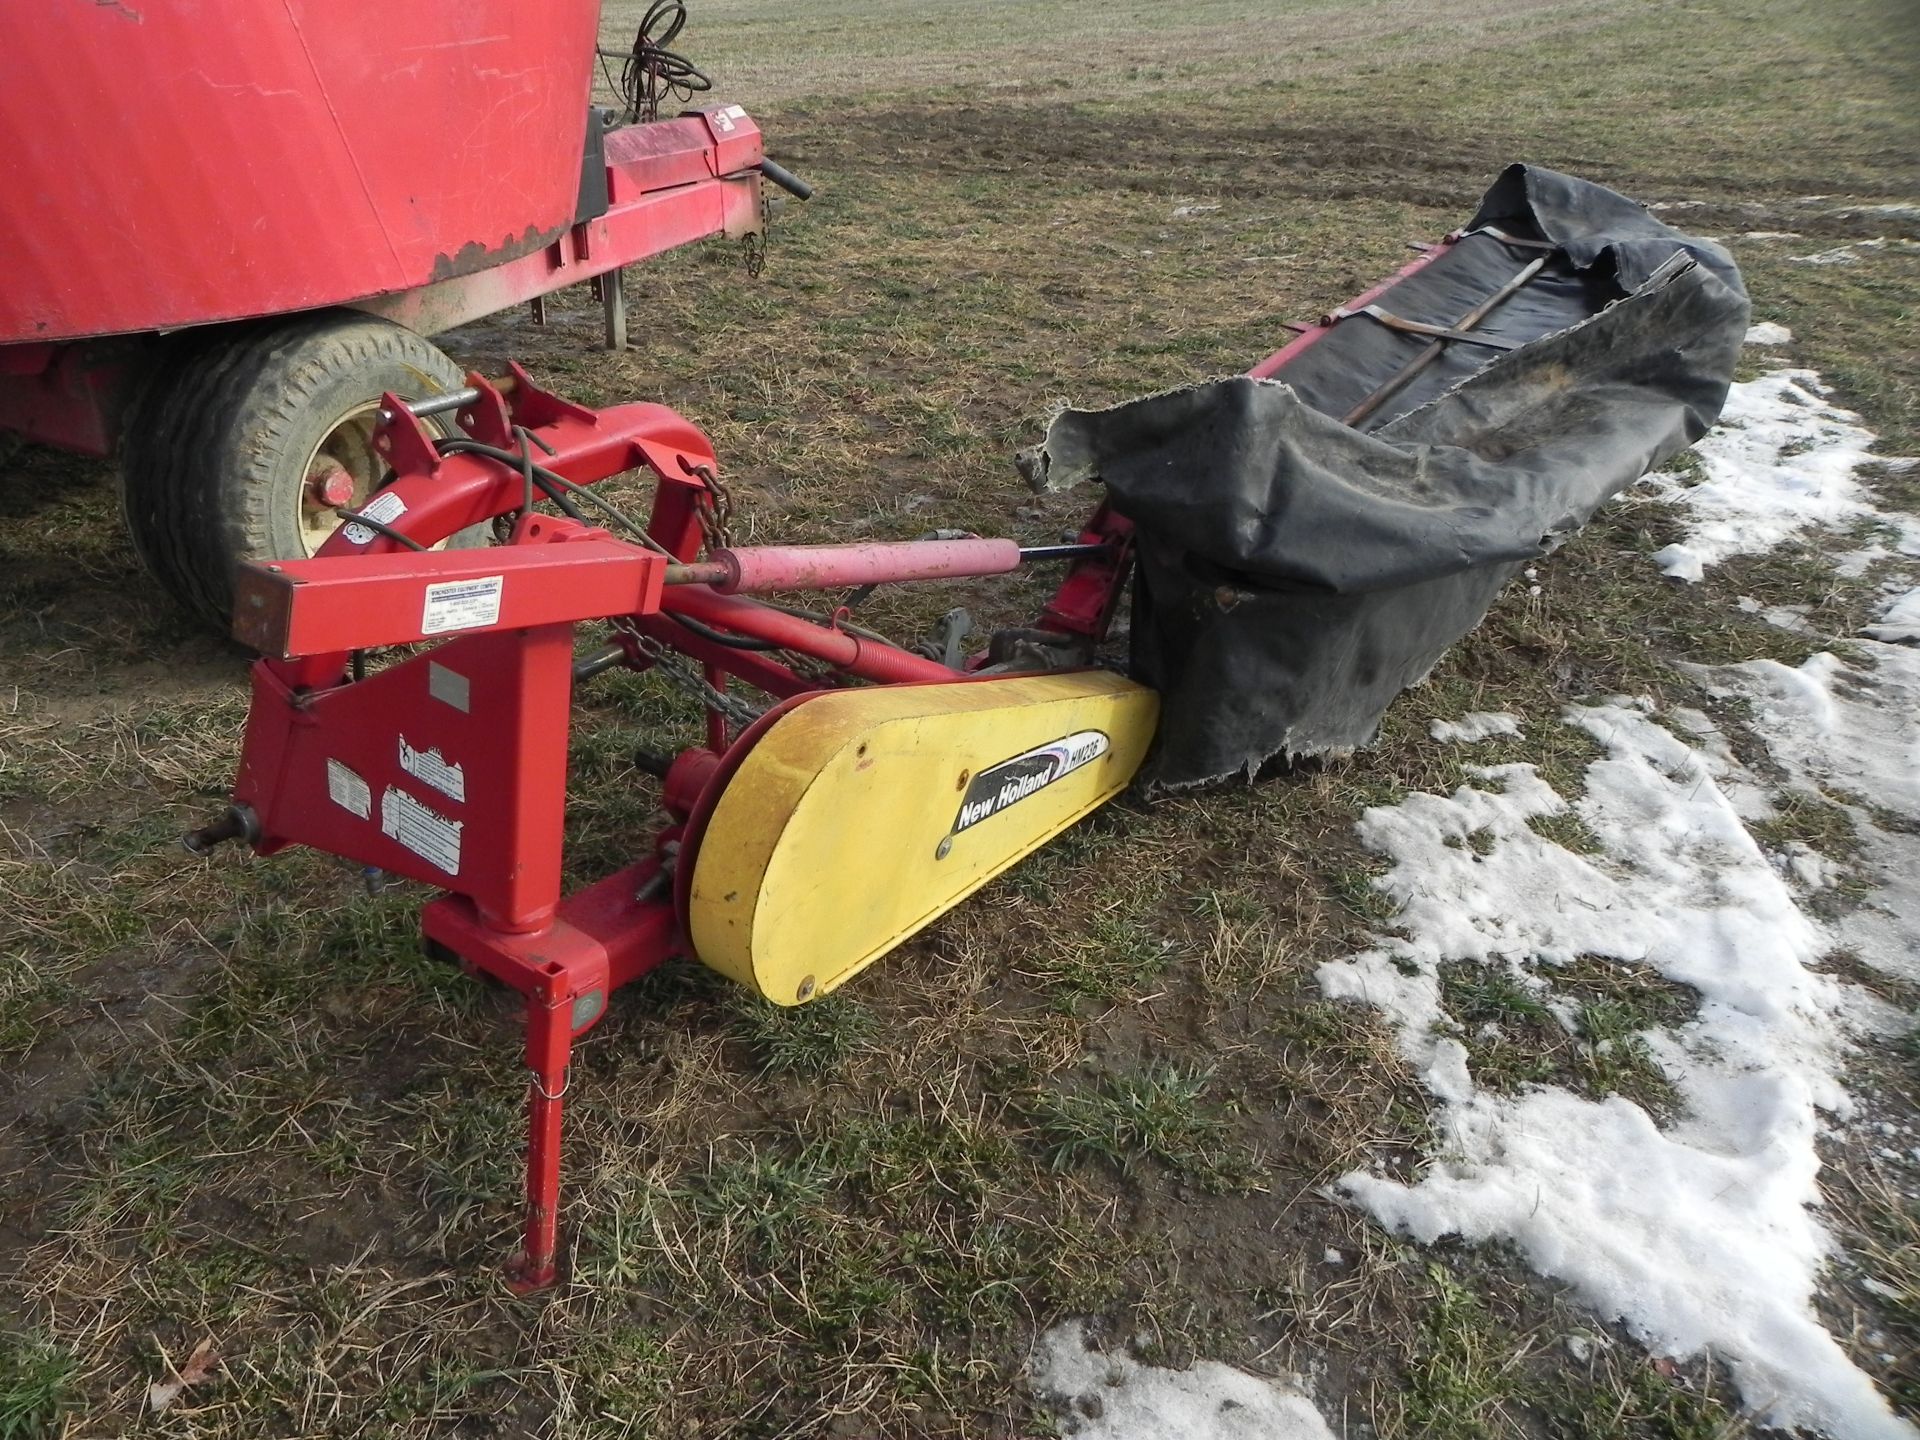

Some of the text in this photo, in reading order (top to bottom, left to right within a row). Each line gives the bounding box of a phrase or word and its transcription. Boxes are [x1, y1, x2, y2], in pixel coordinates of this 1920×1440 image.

[1069, 739, 1100, 769] HM236
[957, 761, 1054, 830] New Holland
